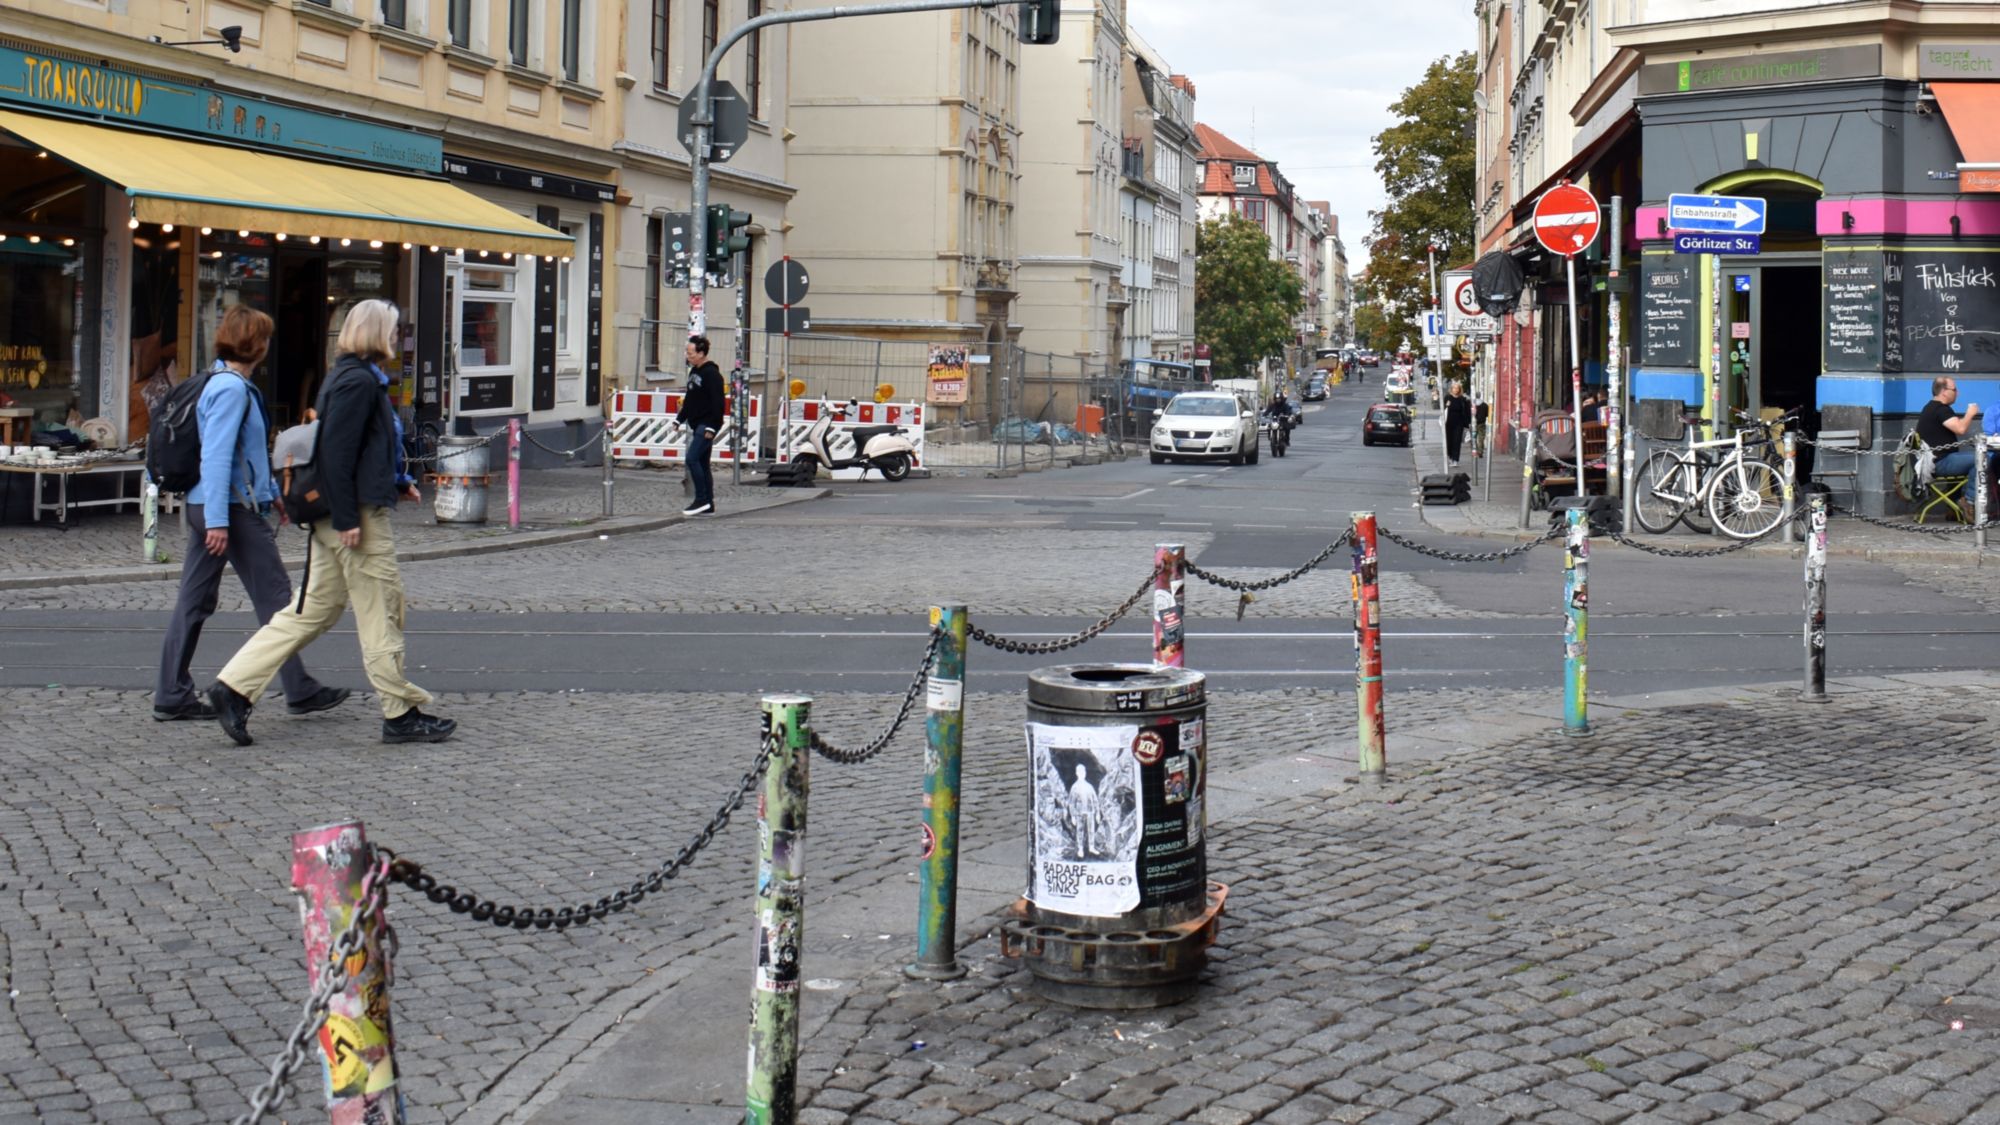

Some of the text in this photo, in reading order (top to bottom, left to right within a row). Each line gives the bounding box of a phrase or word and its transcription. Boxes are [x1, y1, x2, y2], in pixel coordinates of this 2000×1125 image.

[1928, 49, 1952, 67] tag
[1952, 56, 1993, 72] nacht
[1731, 54, 1820, 82] continental
[24, 56, 143, 116] TRANQUILLO
[1675, 207, 1738, 219] Einbahnstraße
[1680, 237, 1756, 250] Görlitzer Str.
[1914, 263, 1996, 290] Frühstück
[1946, 304, 1958, 317] 8
[1459, 318, 1487, 329] ZONE
[1945, 335, 1962, 351] 16
[1941, 353, 1965, 370] Uhr
[1043, 862, 1088, 877] RADARE
[1044, 871, 1081, 887] GHOST
[1086, 874, 1115, 886] BAG
[1047, 881, 1080, 895] SINKS
